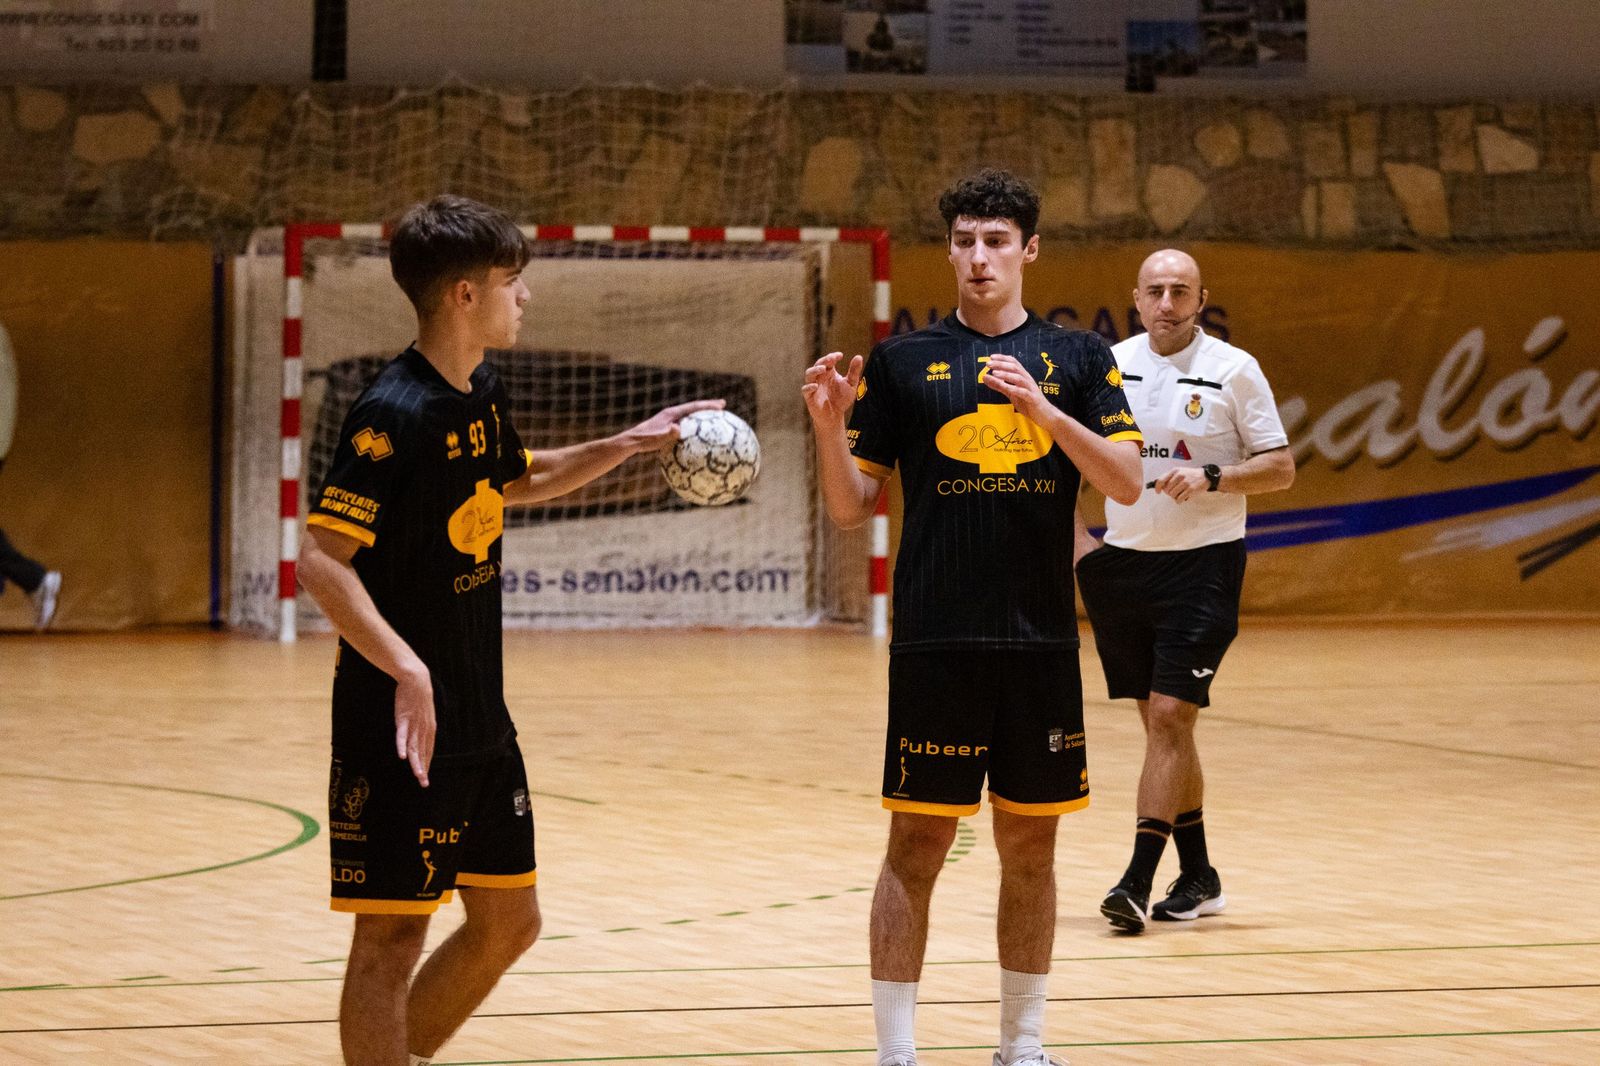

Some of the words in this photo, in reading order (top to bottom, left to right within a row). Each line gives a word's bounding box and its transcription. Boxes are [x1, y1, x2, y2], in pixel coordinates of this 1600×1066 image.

[926, 373, 952, 381] errea
[469, 420, 486, 457] 93
[959, 424, 997, 453] 20
[937, 477, 1029, 496] CONGESA
[1034, 479, 1056, 495] XXI
[900, 737, 989, 757] Pubeer
